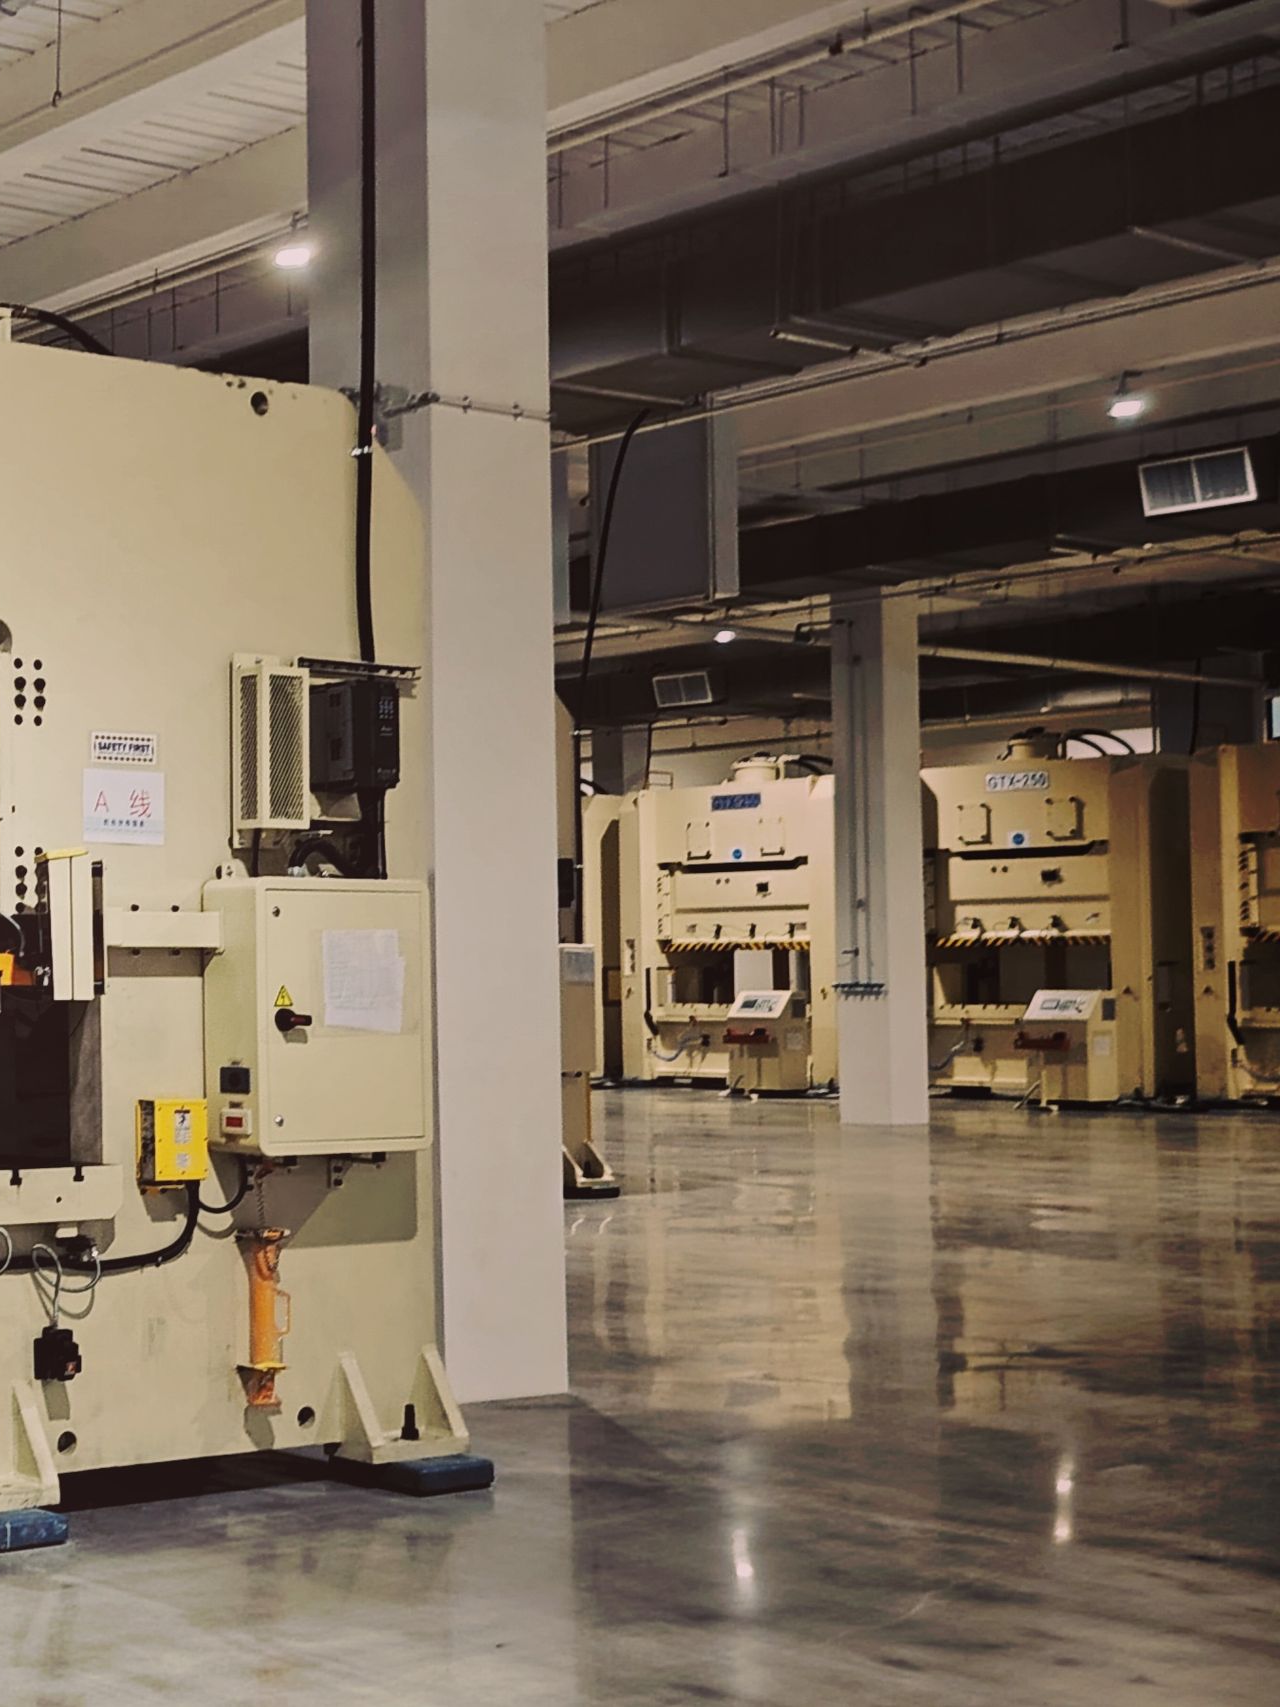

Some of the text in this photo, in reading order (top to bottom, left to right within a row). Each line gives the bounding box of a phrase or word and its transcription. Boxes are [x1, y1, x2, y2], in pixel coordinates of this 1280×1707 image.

[98, 741, 151, 753] SAFETY FIRST
[94, 790, 110, 813] A
